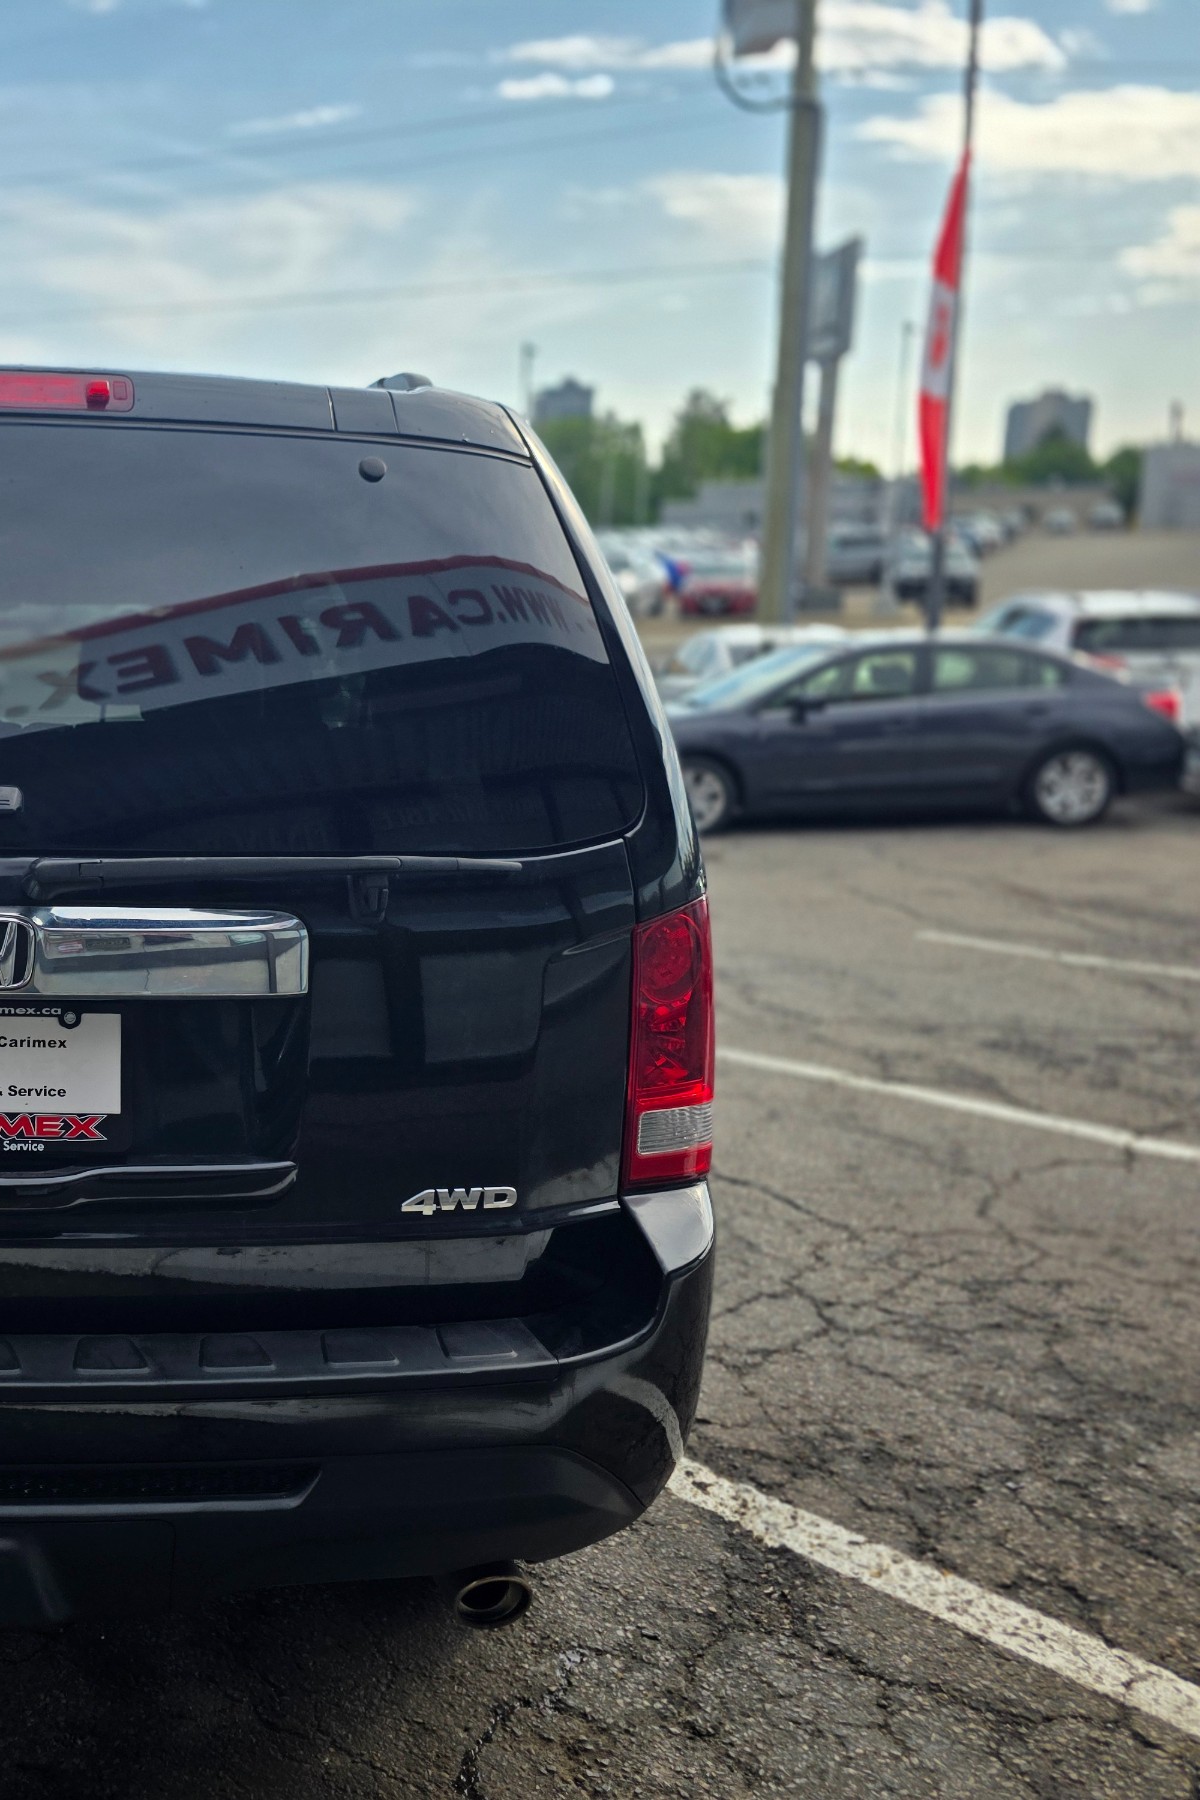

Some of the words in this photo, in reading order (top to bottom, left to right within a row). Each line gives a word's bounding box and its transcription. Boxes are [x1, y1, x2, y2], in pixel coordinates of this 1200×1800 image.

[7, 1085, 67, 1098] Service
[2, 1141, 45, 1152] Service
[401, 1186, 518, 1215] 4WD
